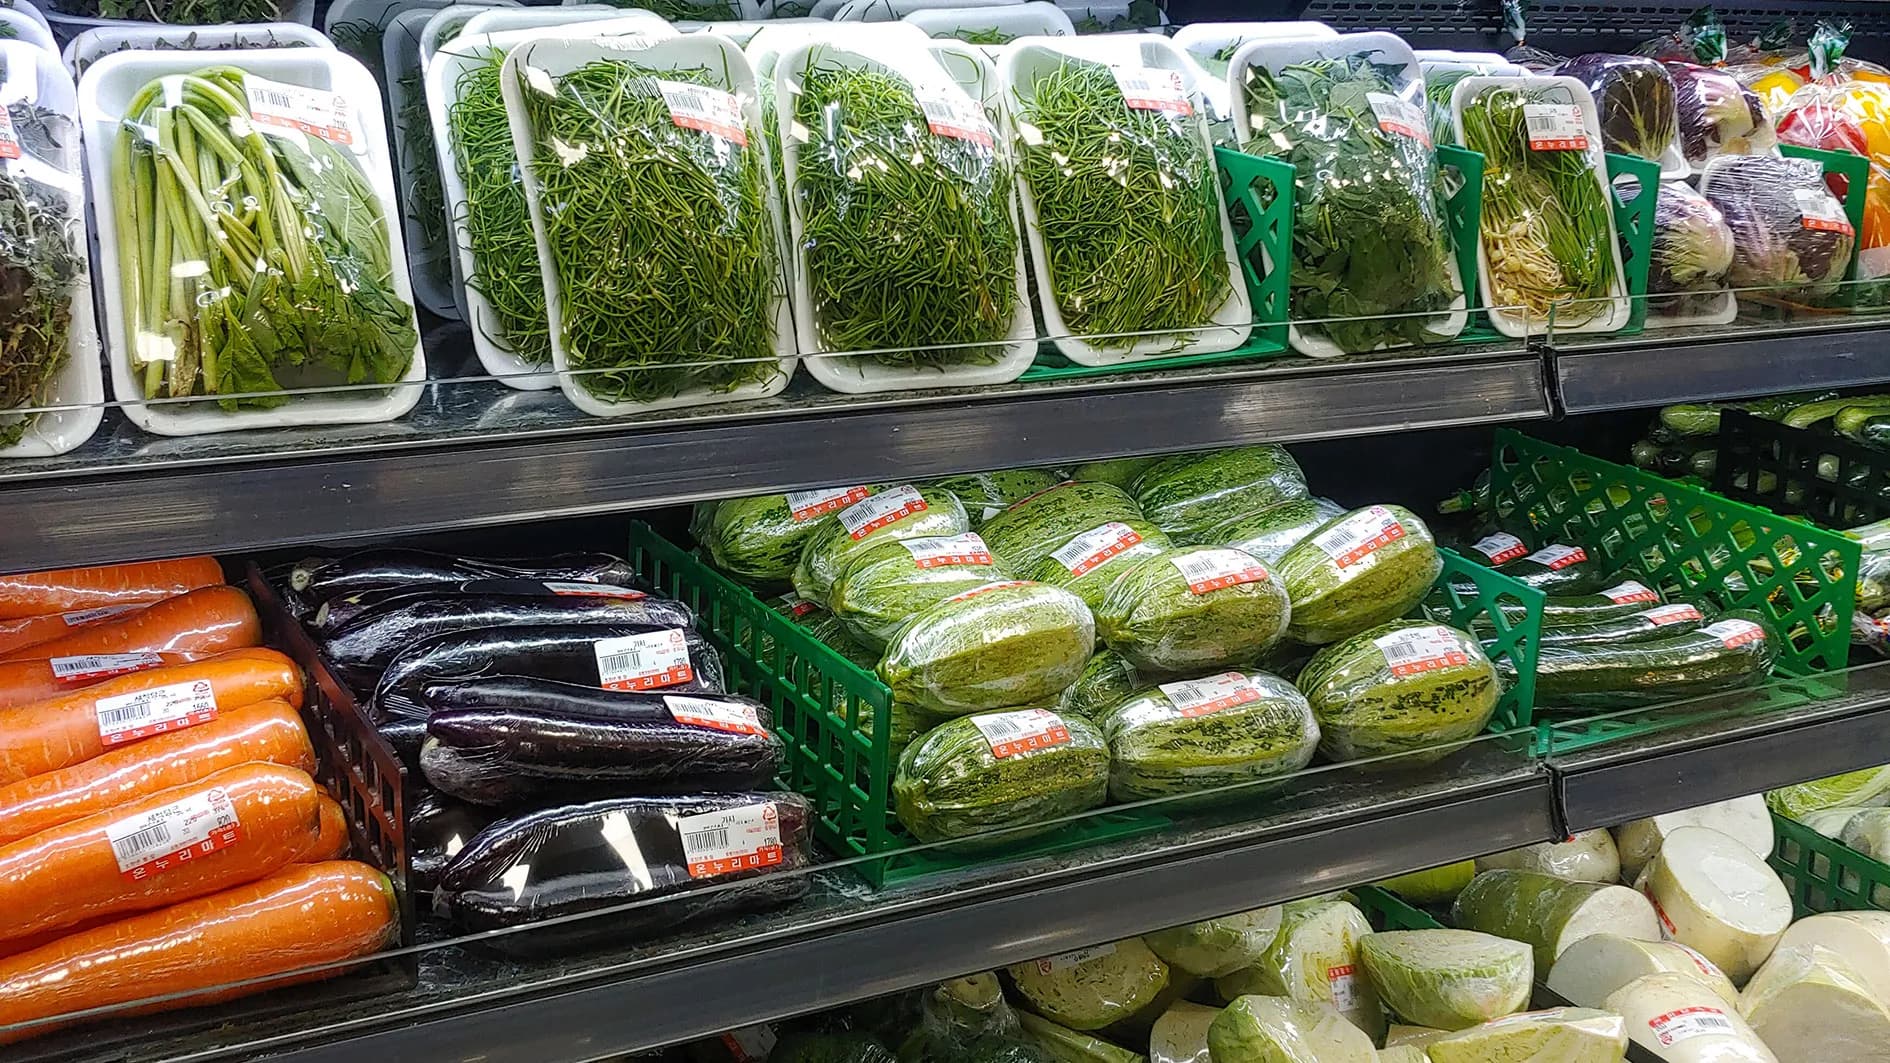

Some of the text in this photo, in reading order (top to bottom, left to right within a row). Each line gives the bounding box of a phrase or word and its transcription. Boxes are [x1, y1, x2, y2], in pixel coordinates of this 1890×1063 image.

[111, 712, 211, 743] 온누리마트
[132, 831, 237, 880] 온누리마트
[695, 851, 778, 875] 온누리마트
